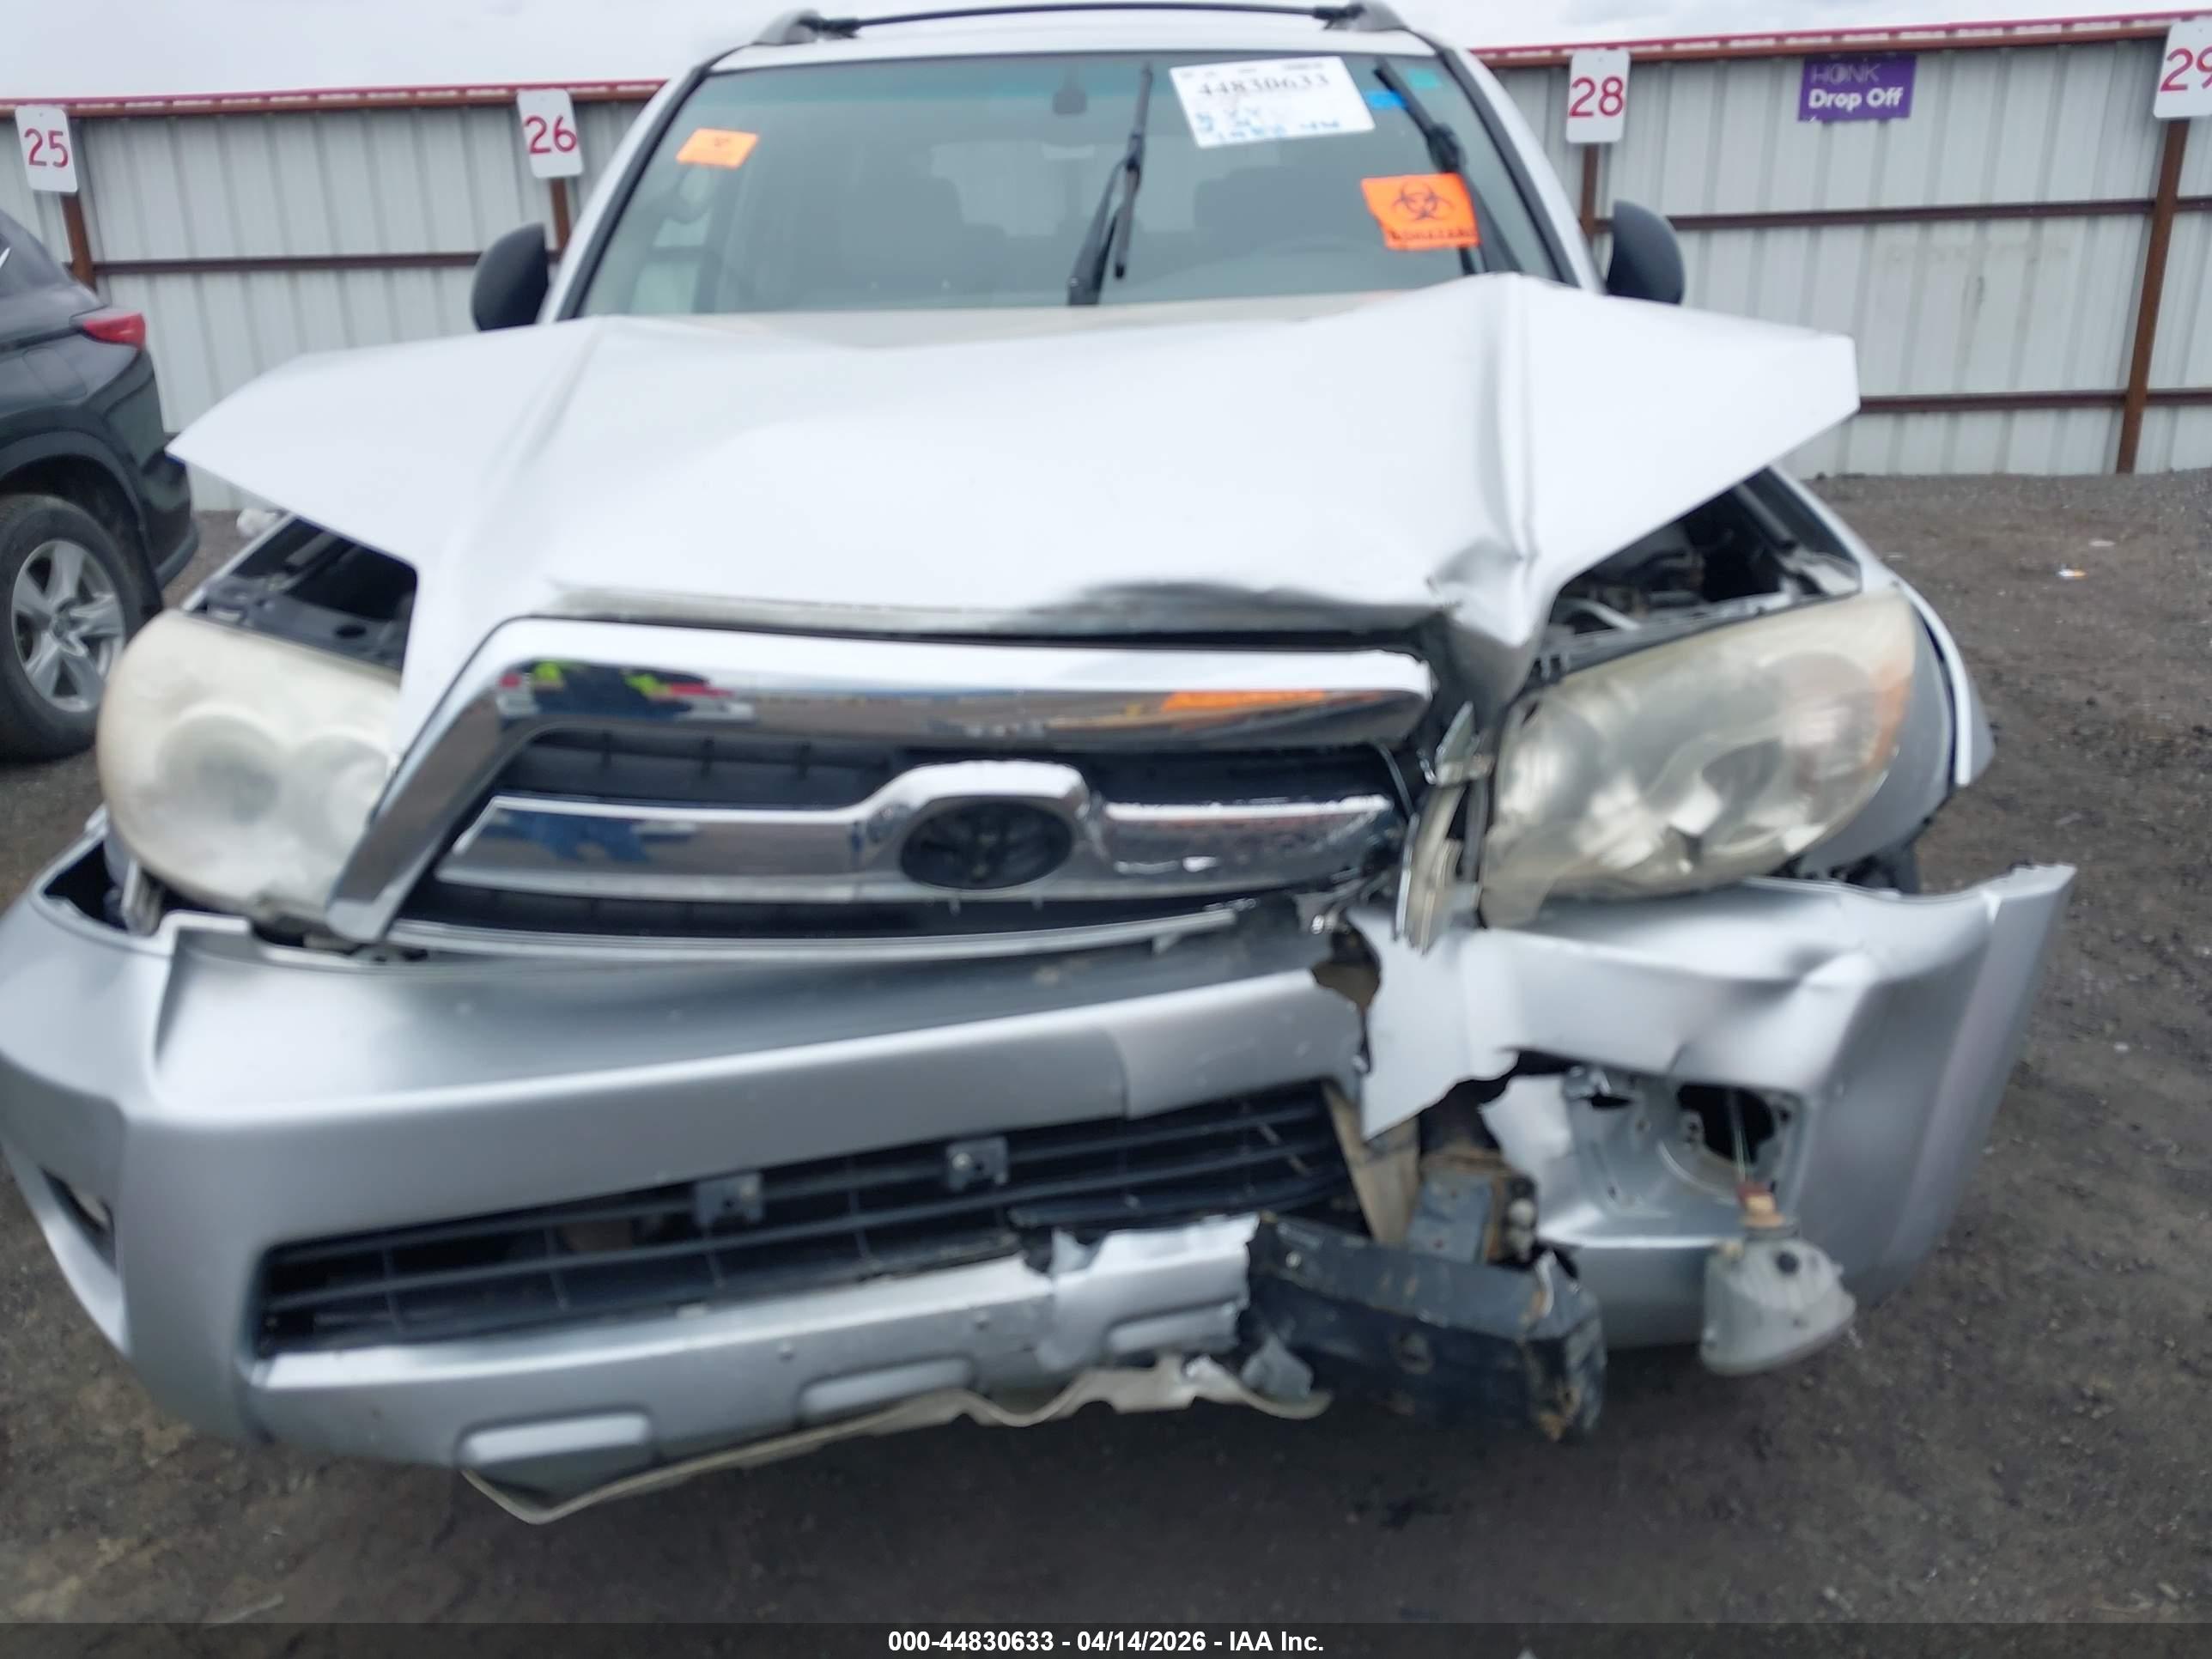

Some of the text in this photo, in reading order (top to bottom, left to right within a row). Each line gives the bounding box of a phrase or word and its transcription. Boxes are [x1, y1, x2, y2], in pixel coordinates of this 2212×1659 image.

[1810, 63, 1881, 84] HONK
[2160, 46, 2212, 92] 29
[1569, 76, 1623, 117] 28
[1808, 87, 1904, 112] Drop Off
[24, 128, 68, 167] 25
[525, 114, 577, 153] 26
